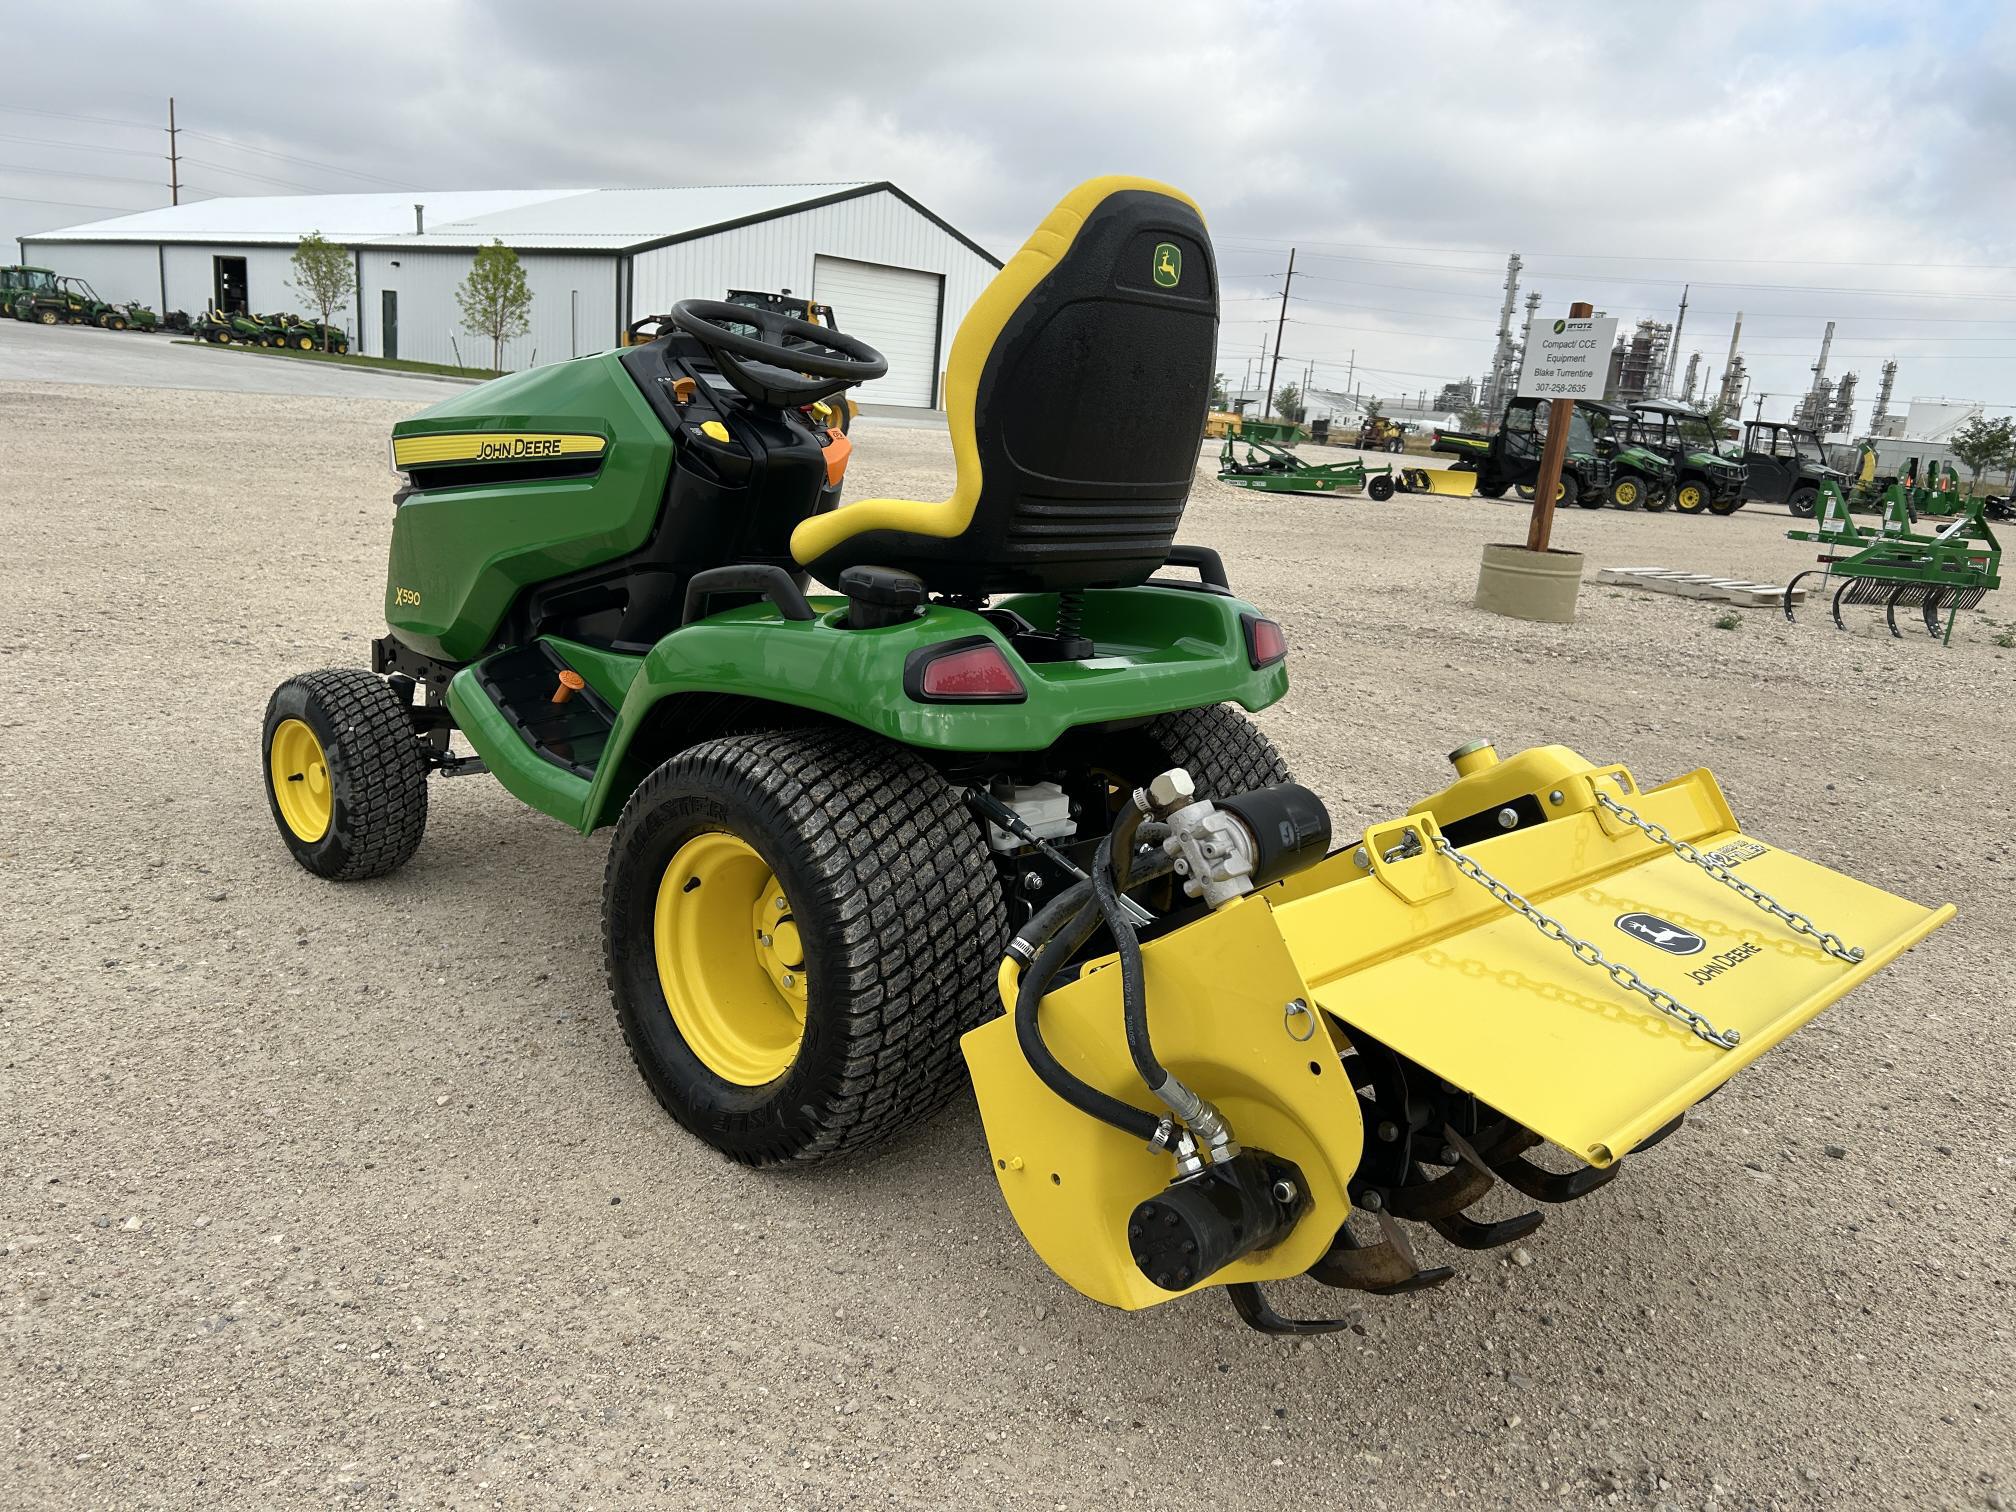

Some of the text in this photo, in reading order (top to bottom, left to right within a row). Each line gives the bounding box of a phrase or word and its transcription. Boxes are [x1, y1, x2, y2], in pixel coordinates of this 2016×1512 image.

[1542, 339, 1597, 349] Compact/ CCE
[1546, 353, 1586, 363] Equipment
[1534, 368, 1593, 378] Blake Turrentine
[1535, 382, 1586, 393] 307-258-2635
[476, 439, 562, 459] JOHN DEERE
[395, 586, 421, 607] X590
[626, 795, 728, 863] MASTER
[1684, 942, 1762, 985] JOHN DEERE
